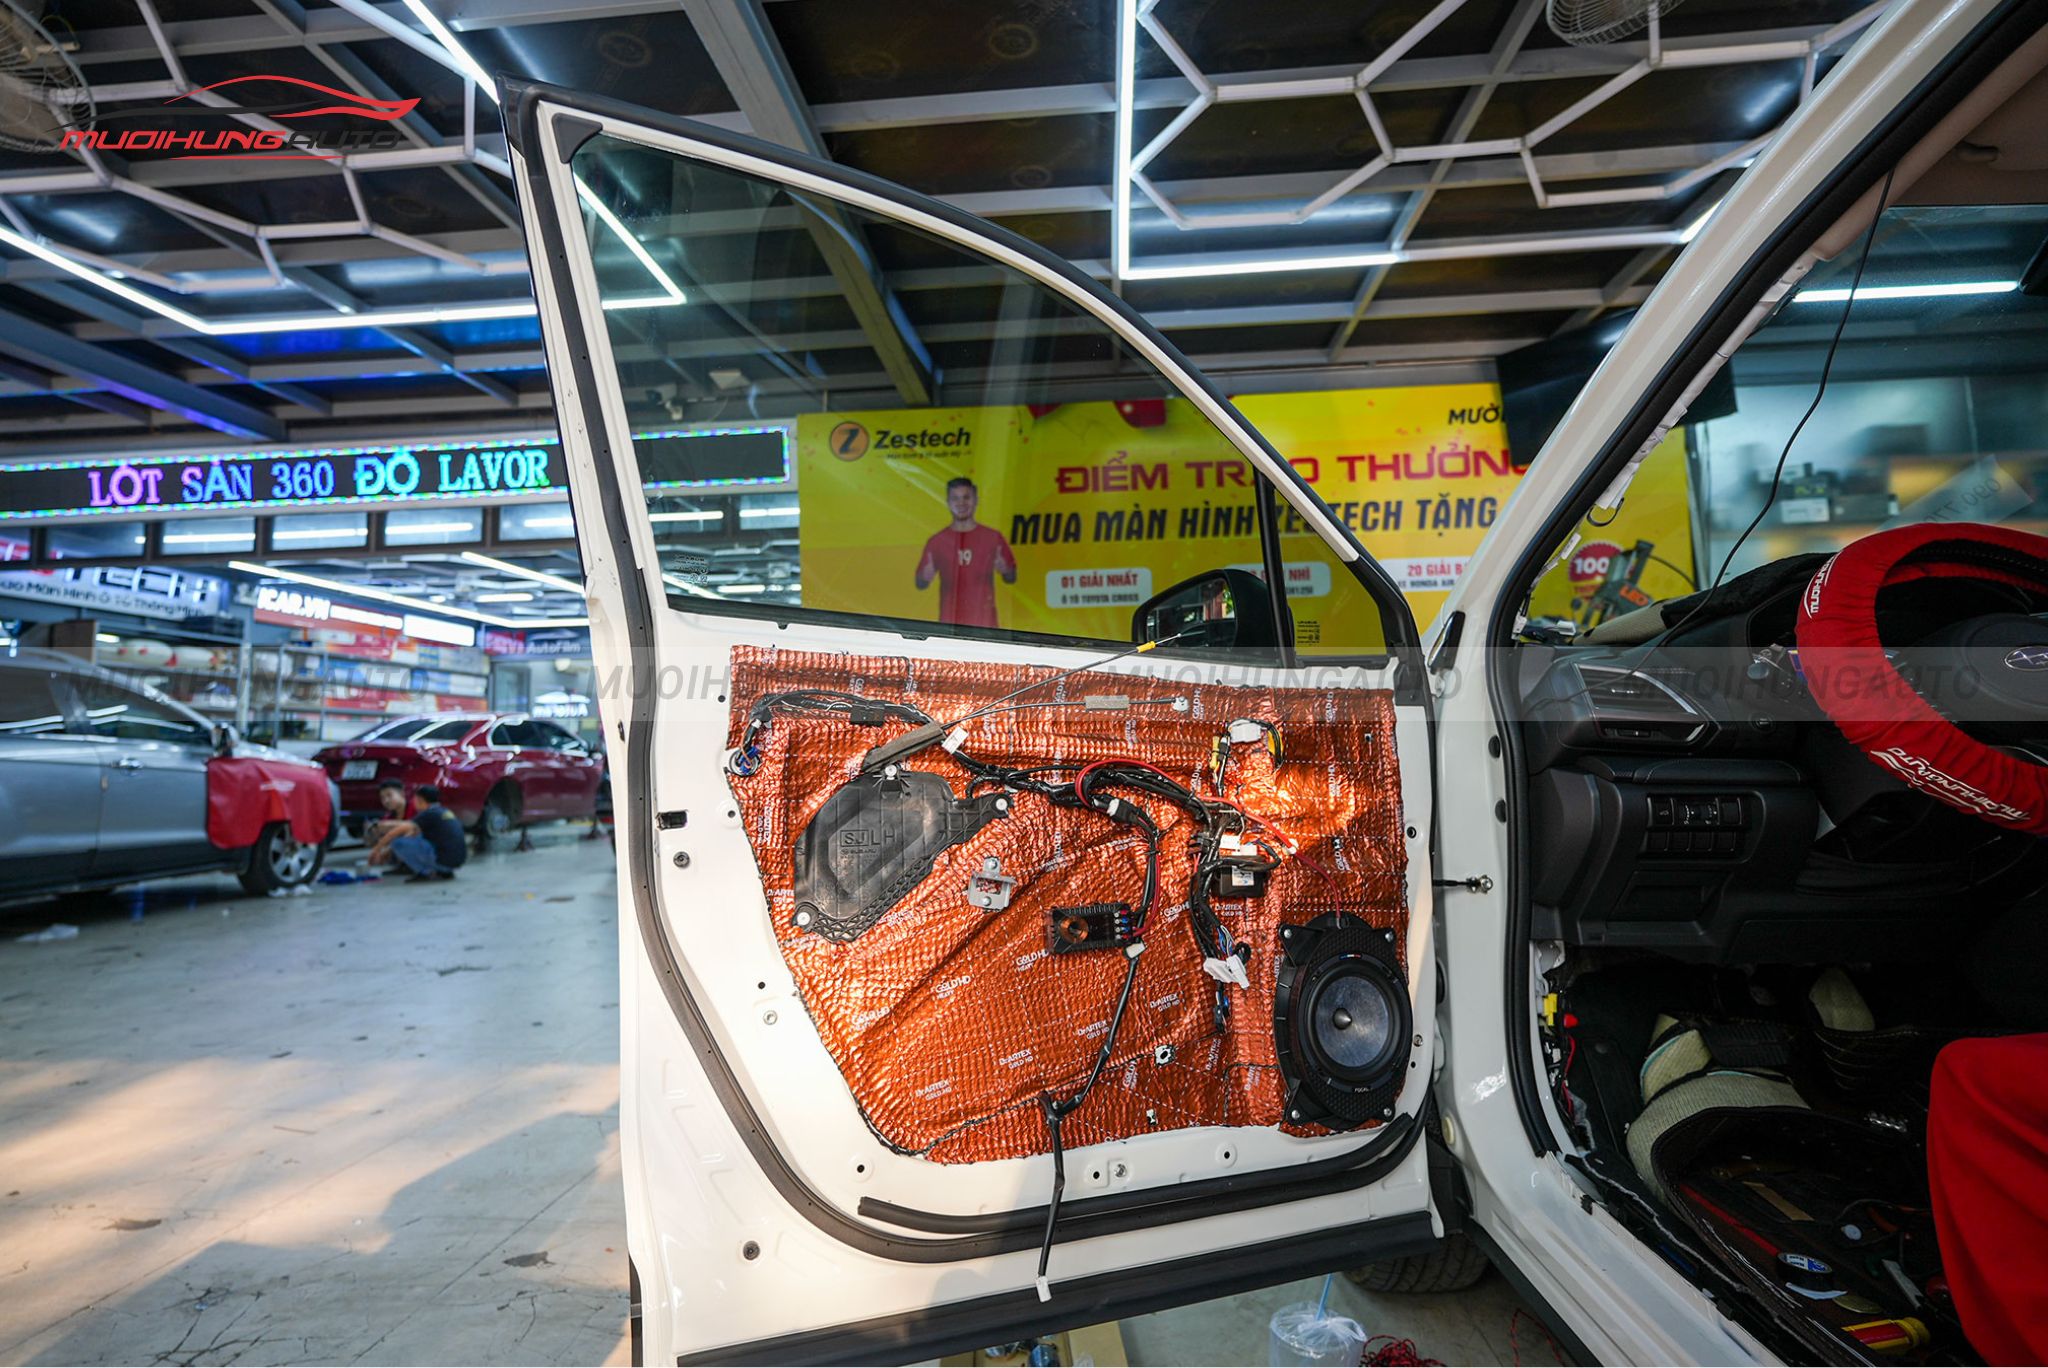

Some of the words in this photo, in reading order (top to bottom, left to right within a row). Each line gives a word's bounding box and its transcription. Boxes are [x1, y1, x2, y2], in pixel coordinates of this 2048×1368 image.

[1448, 403, 1506, 425] MƯỜ
[874, 427, 971, 450] Zestech
[271, 459, 334, 499] 360
[438, 449, 551, 493] LAVOR
[1055, 451, 1169, 494] ĐIỂM
[1185, 457, 1320, 489] TRO
[1337, 443, 1529, 483] THƯỞN
[1010, 512, 1082, 545] MUA
[1093, 503, 1168, 542] MÀN
[1179, 501, 1255, 539] HÌNH
[1416, 493, 1498, 537] TẶNG
[957, 549, 973, 565] 19
[1573, 557, 1610, 575] 100
[1061, 576, 1075, 589] 01
[1079, 571, 1104, 588] GIẢI
[1106, 568, 1139, 587] NHẤT
[1407, 564, 1423, 577] 20
[1426, 560, 1451, 577] GIẢI
